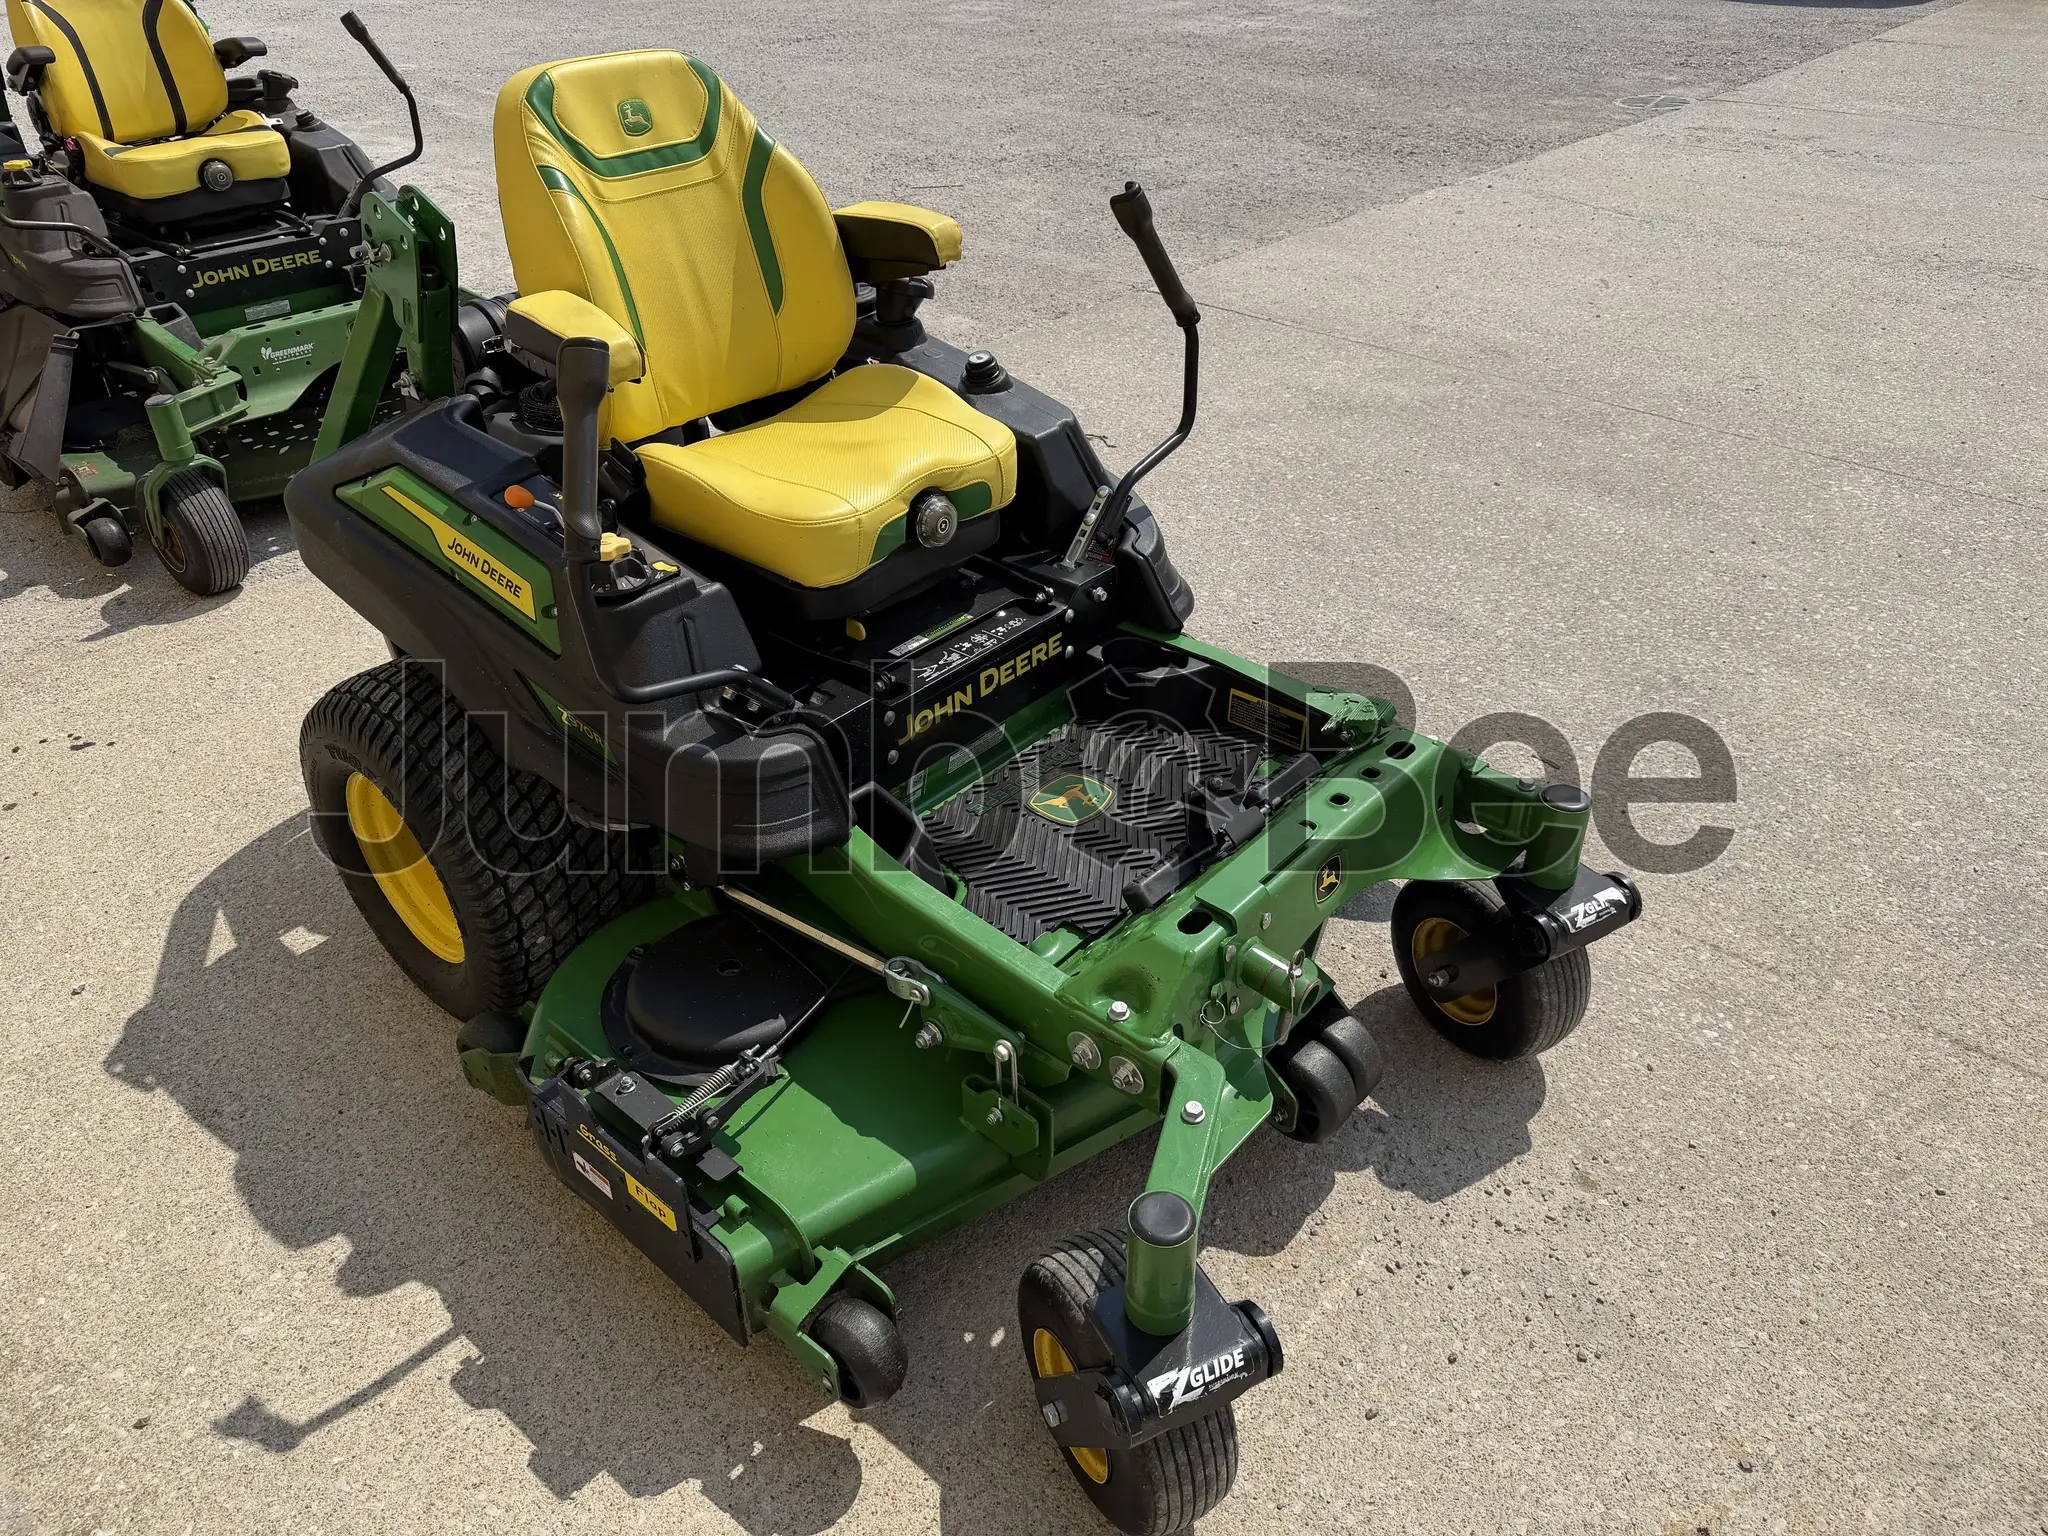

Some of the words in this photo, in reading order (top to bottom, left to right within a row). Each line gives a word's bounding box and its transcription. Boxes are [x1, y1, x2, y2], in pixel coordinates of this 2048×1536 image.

[193, 264, 250, 289] JOHN
[252, 249, 322, 276] DEERE
[270, 343, 314, 359] GREENMARK
[447, 537, 480, 568] JOHN
[480, 558, 522, 599] DEERE
[898, 684, 973, 746] JOHN
[979, 632, 1063, 698] DEERE
[579, 1123, 618, 1162] Grass
[634, 1184, 667, 1219] Flap
